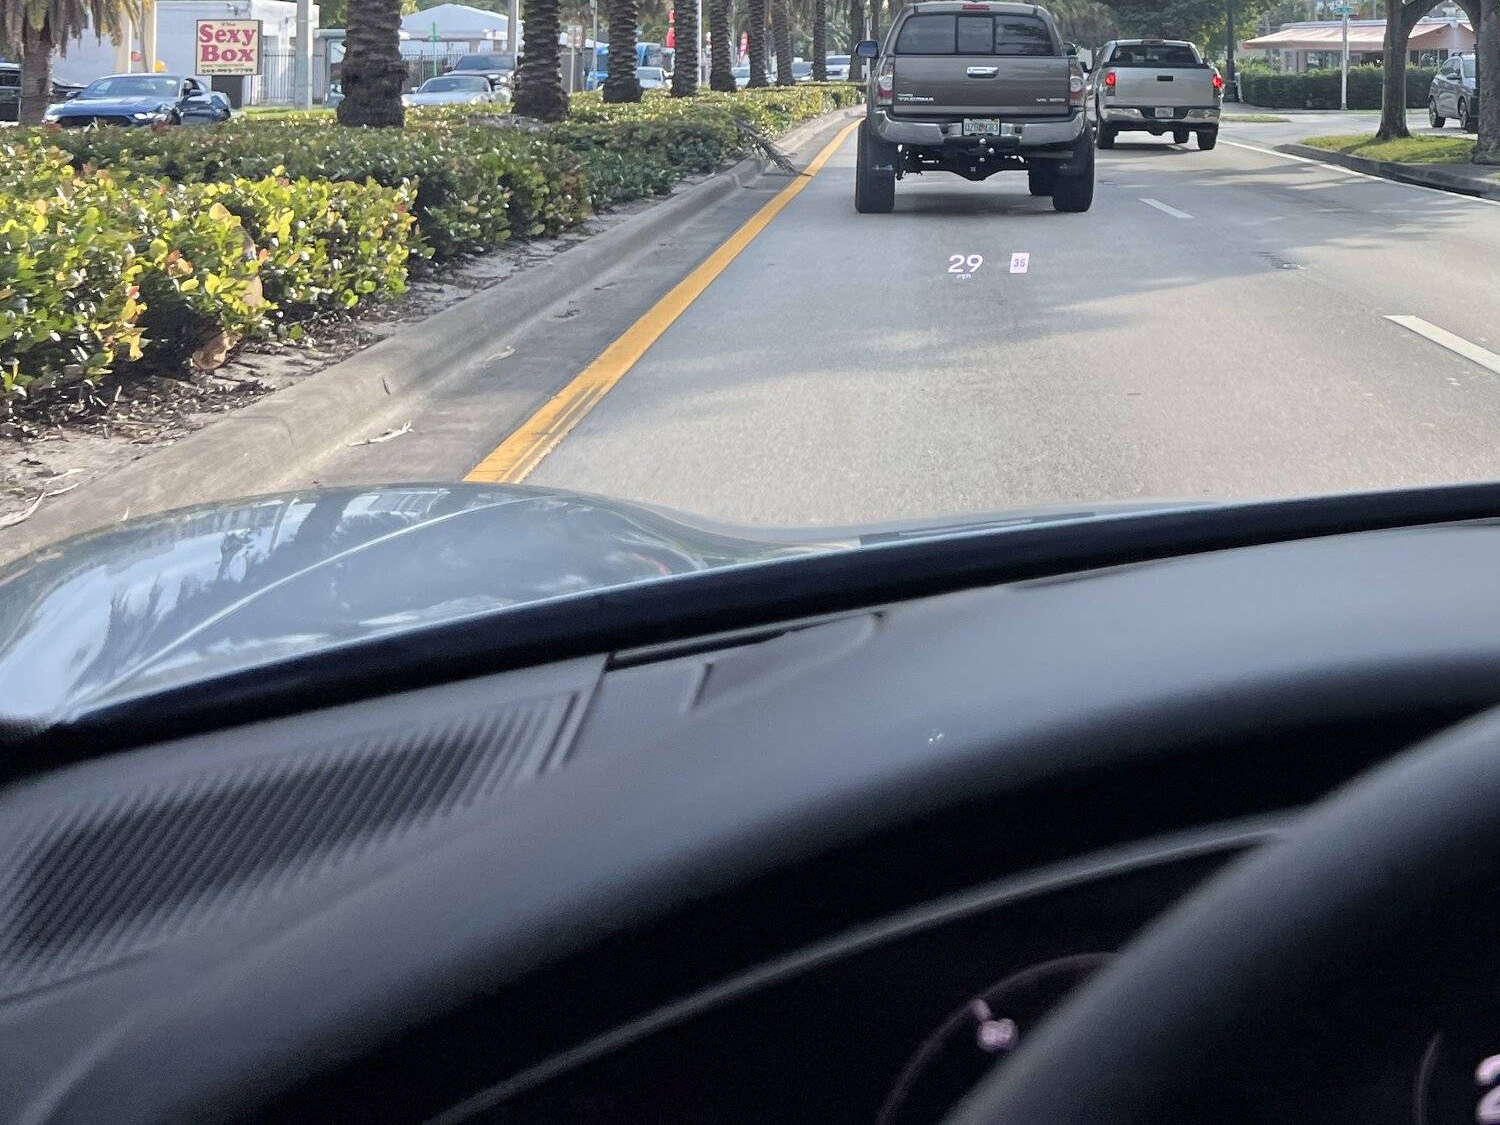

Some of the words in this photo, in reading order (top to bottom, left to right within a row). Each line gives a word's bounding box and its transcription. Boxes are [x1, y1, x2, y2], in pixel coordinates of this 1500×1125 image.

[199, 24, 256, 46] Sexy
[200, 44, 255, 62] Box
[948, 254, 984, 273] 29
